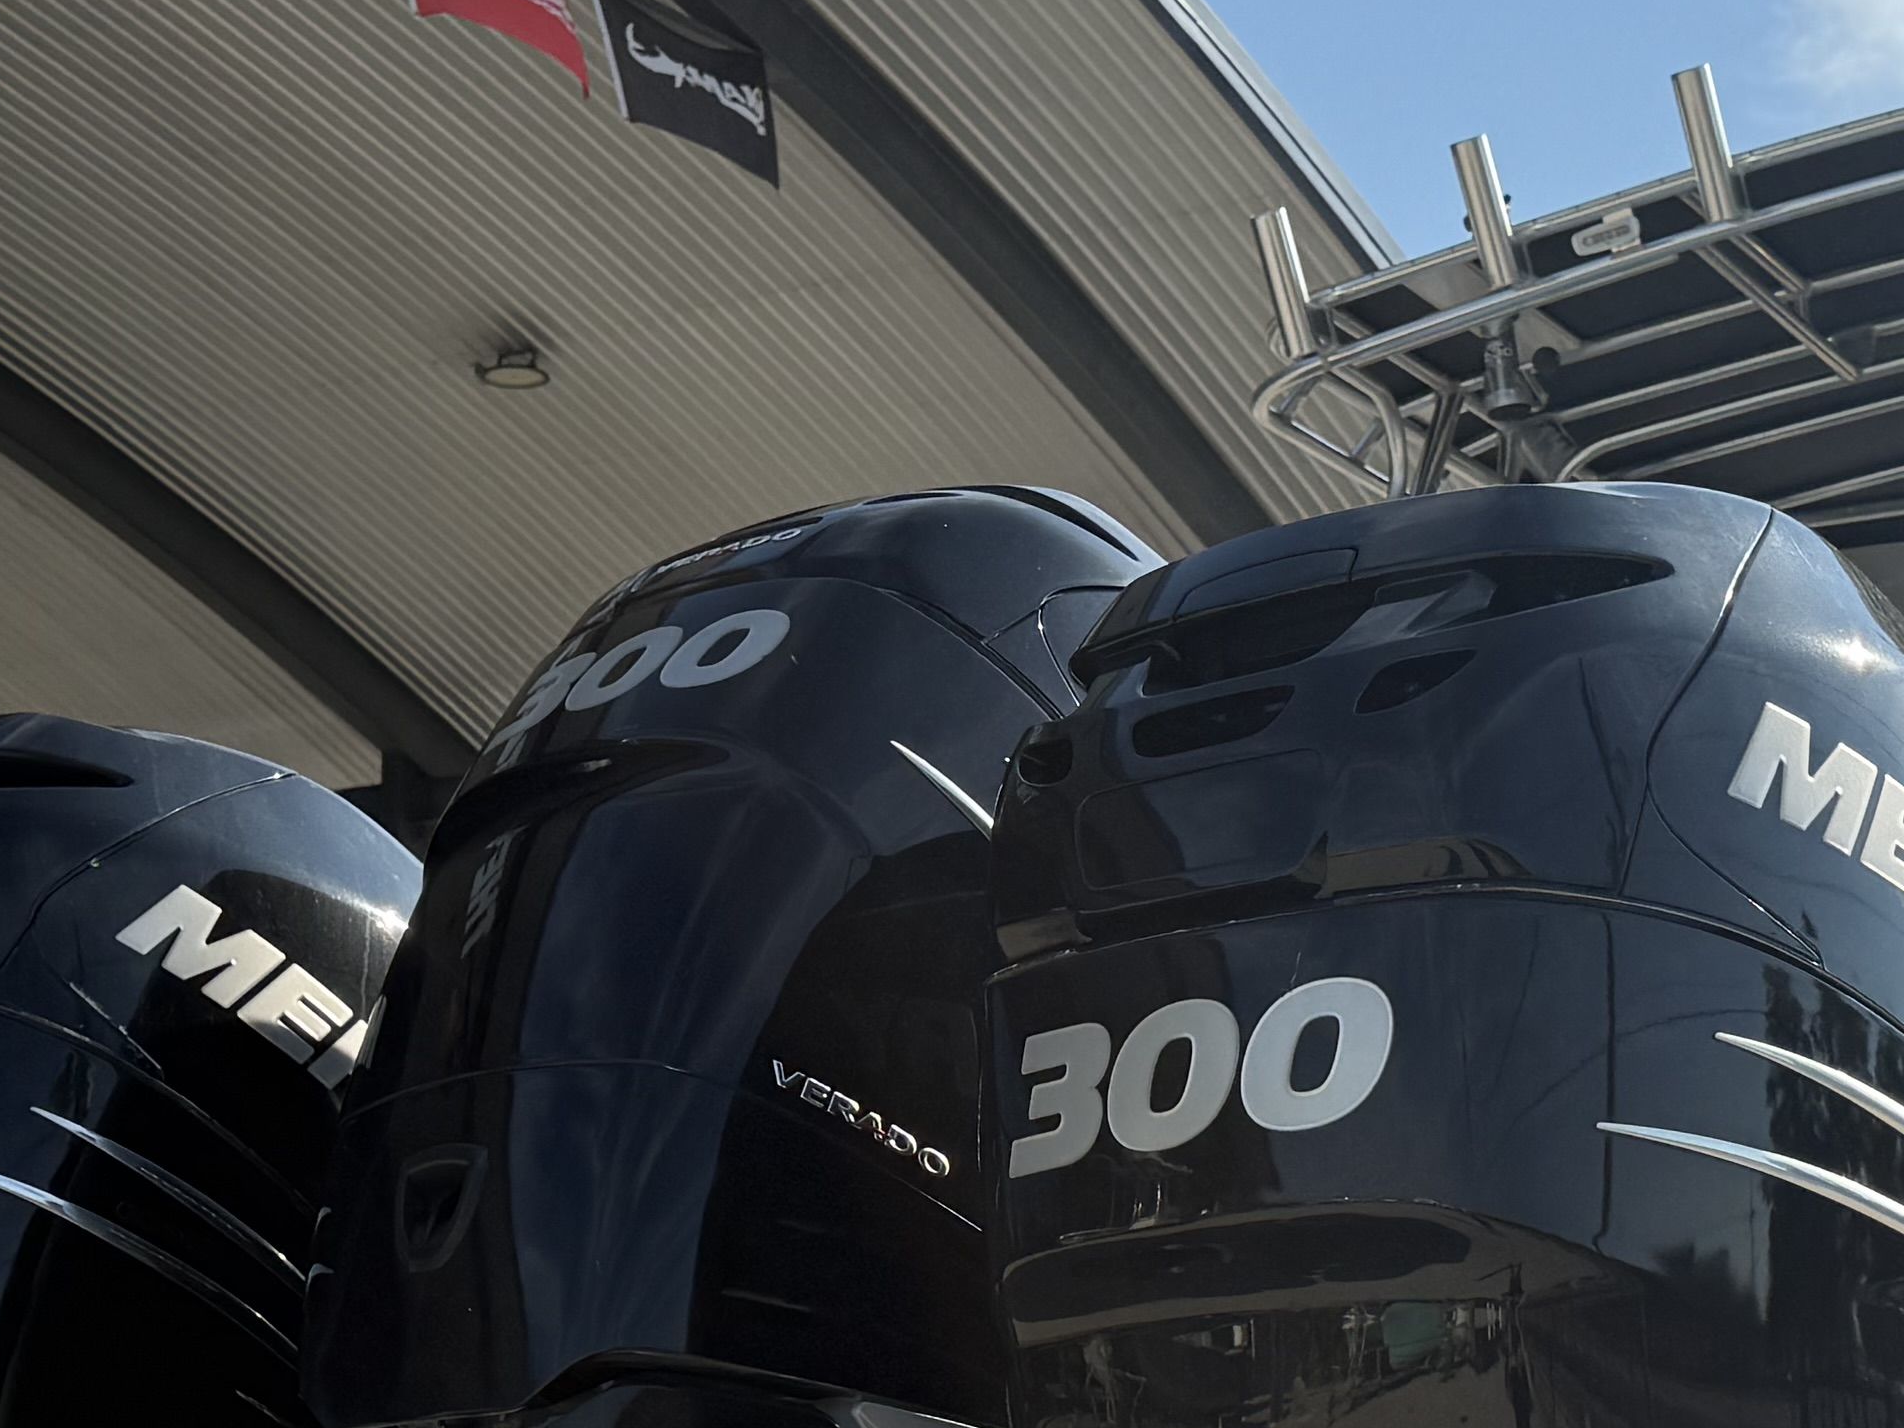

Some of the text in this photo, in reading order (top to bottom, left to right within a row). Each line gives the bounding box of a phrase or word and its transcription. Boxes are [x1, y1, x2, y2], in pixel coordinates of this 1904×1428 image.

[482, 608, 791, 756] 300
[772, 1059, 950, 1177] VERADO
[1008, 976, 1394, 1179] 300
